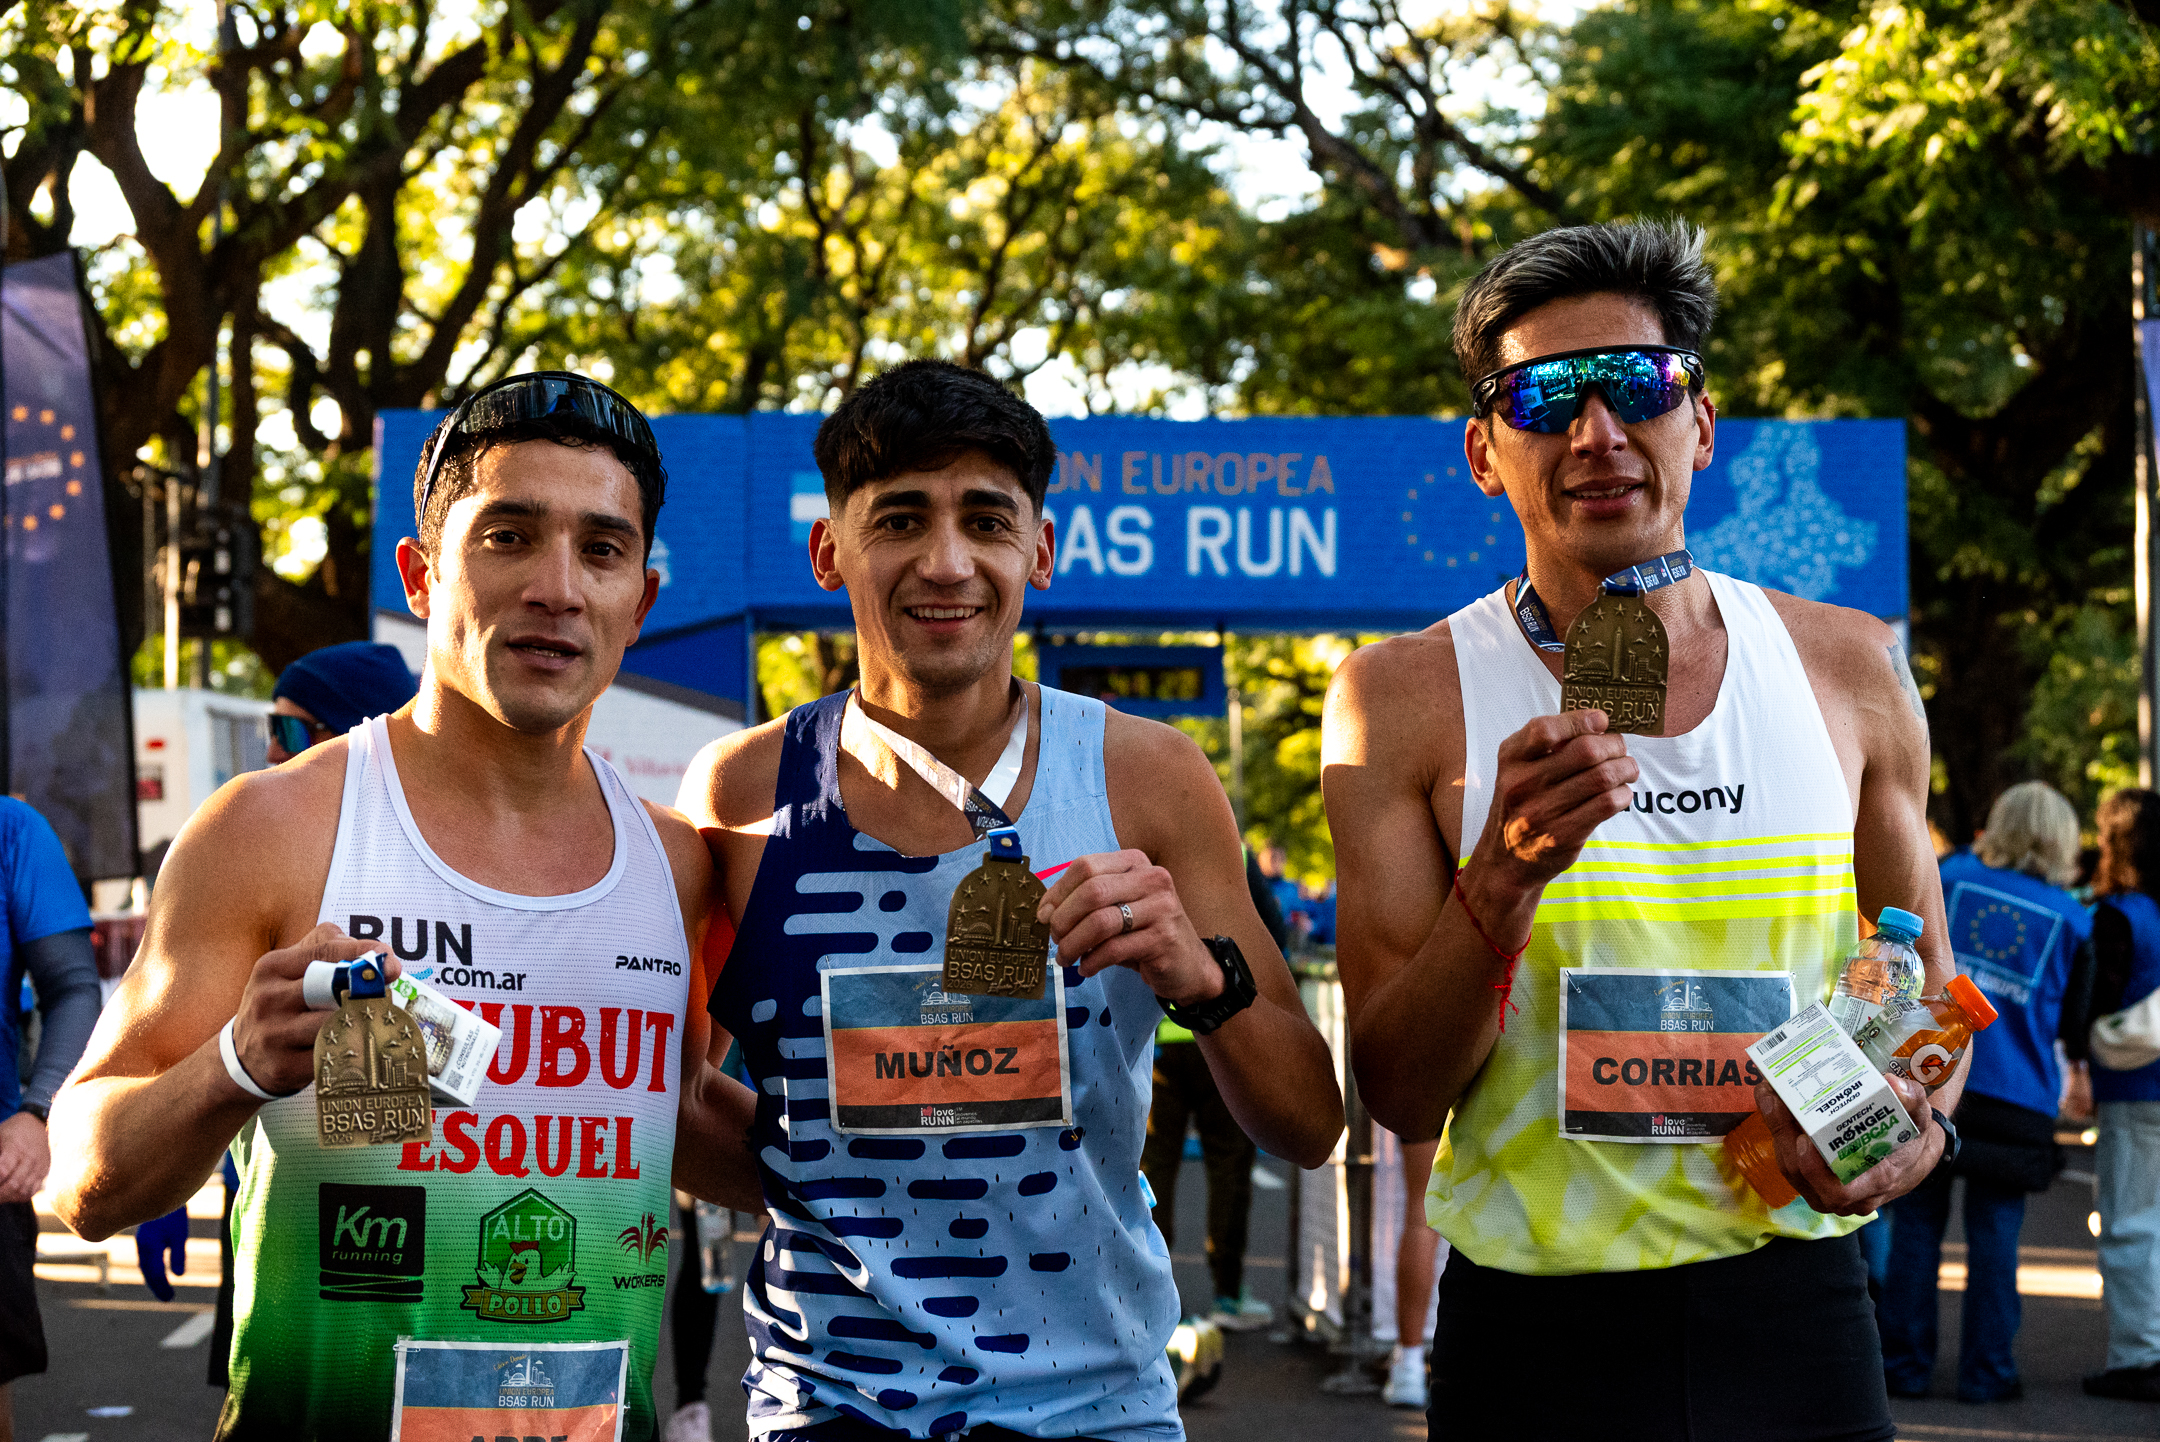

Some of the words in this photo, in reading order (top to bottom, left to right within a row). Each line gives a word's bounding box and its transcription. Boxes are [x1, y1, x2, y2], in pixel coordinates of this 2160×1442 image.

[1122, 451, 1335, 497] EUROPEA
[1042, 504, 1153, 576] AS
[1187, 504, 1338, 578] RUN
[1566, 685, 1603, 698] UNION
[1607, 688, 1660, 702] EUROPEA
[1622, 701, 1660, 720] RUN
[1624, 784, 1745, 814] ucony
[349, 914, 473, 966] RUN
[615, 955, 682, 976] PANTRO
[949, 948, 985, 962] UNION
[989, 951, 1039, 966] EUROPEA
[435, 967, 527, 991] .com.ar
[948, 961, 996, 981] BSAS
[1002, 965, 1040, 984] RUN
[920, 1013, 948, 1025] BSAS
[951, 1012, 974, 1024] RUN
[1660, 1019, 1688, 1031] BSAS
[1691, 1020, 1714, 1031] RUN
[450, 998, 675, 1092] UBUT
[875, 1044, 1020, 1080] MUÑOZ
[1592, 1056, 1763, 1086] CORRIAS
[322, 1098, 362, 1113] UNION
[366, 1094, 424, 1110] EUROPEA
[933, 1107, 955, 1117] love
[322, 1111, 376, 1133] BSAS
[384, 1107, 425, 1129] RUN
[920, 1115, 955, 1126] RUNN
[1664, 1116, 1686, 1126] love
[1836, 1103, 1874, 1132] GENTECH
[1651, 1125, 1685, 1135] RUNN
[397, 1109, 641, 1179] ESQUEL
[333, 1204, 408, 1249] Km
[491, 1214, 566, 1241] ALTO
[332, 1250, 403, 1266] running
[489, 1293, 562, 1317] POLLO
[498, 1395, 528, 1407] BSAS
[531, 1395, 555, 1408] RUN
